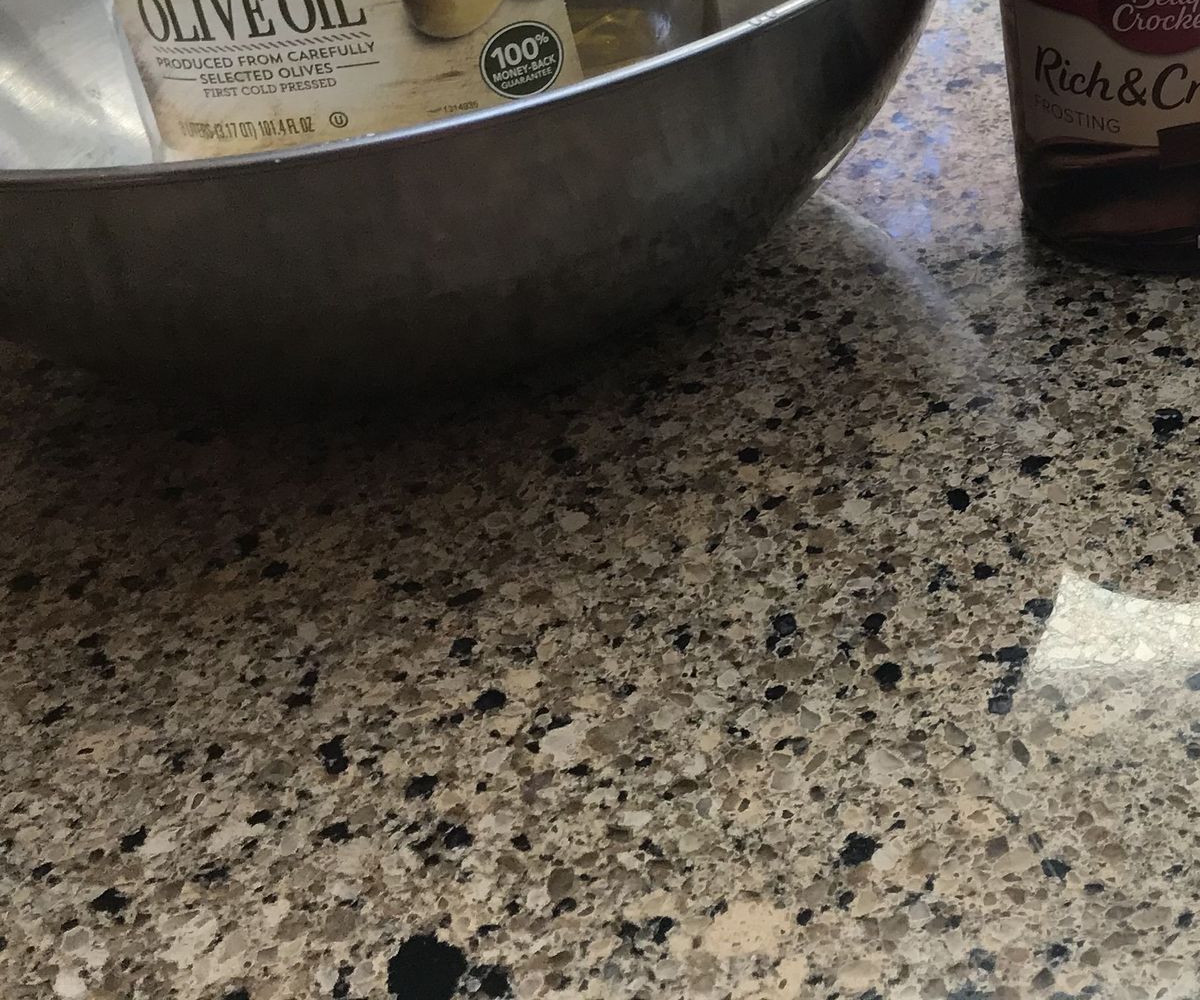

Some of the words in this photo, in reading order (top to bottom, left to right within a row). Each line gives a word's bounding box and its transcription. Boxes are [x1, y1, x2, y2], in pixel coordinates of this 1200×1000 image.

[156, 53, 234, 70] PRODUCED
[238, 52, 284, 67] FROM
[288, 41, 375, 63] CAREFULLY
[490, 32, 550, 69] 100%
[200, 70, 273, 85] SELECTED
[278, 62, 333, 79] OLIVES
[493, 55, 557, 83] MONEY-BACK
[501, 67, 553, 90] GUARANTEE
[203, 87, 238, 99] FIRST
[241, 84, 278, 96] COLD
[280, 77, 337, 94] PRESSED
[258, 118, 287, 137] 101.4
[286, 117, 300, 135] FL
[301, 116, 316, 133] OZ
[1035, 94, 1121, 134] FROSTING
